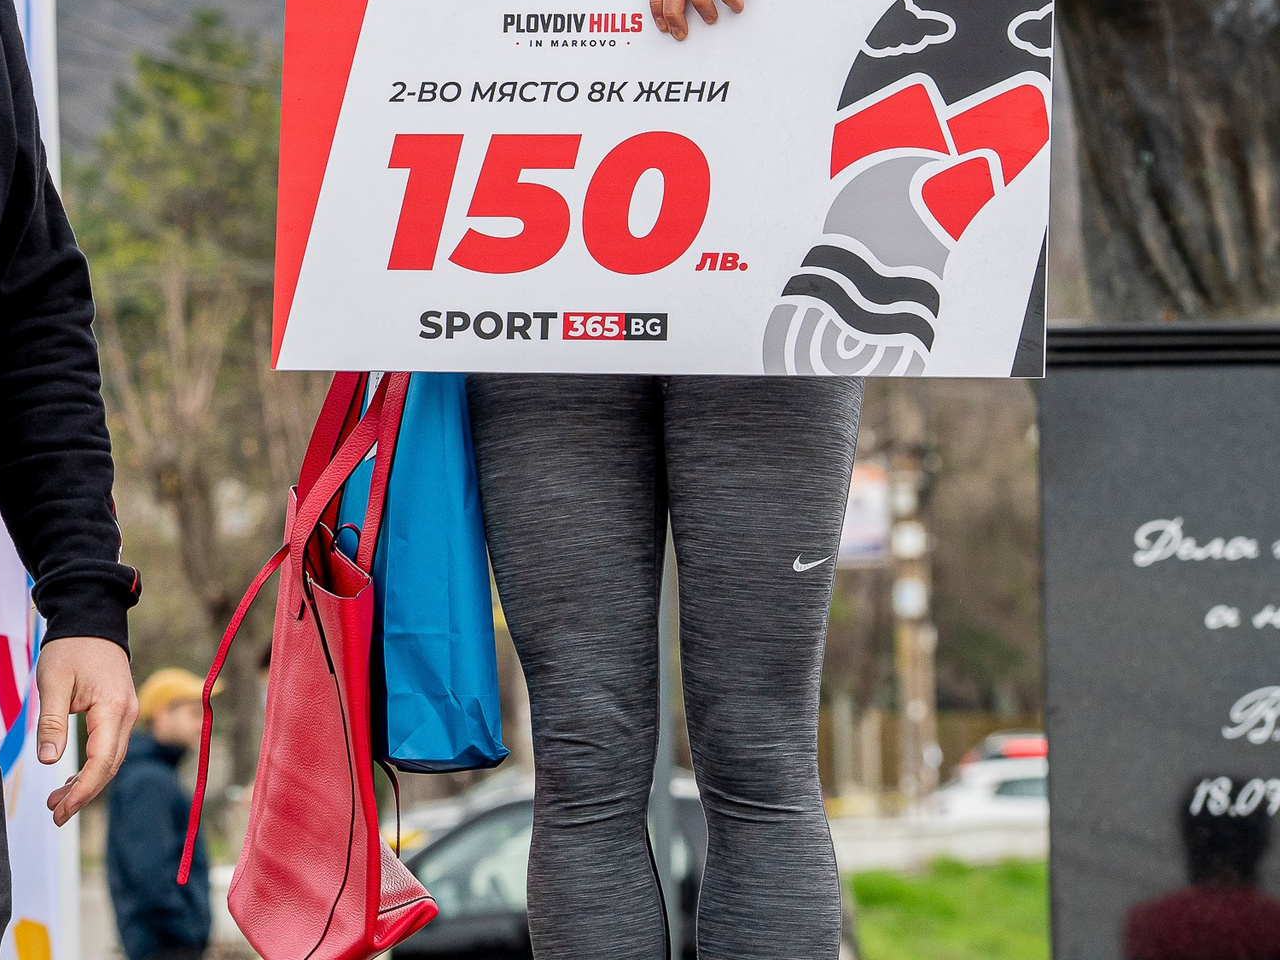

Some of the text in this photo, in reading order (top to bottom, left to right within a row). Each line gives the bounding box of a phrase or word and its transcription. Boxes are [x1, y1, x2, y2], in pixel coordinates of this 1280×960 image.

[503, 13, 643, 33] PLOVDIV HILLS
[388, 81, 731, 102] 2-ВО МЯСТО 8К ЖЕНИ
[387, 131, 711, 275] 150
